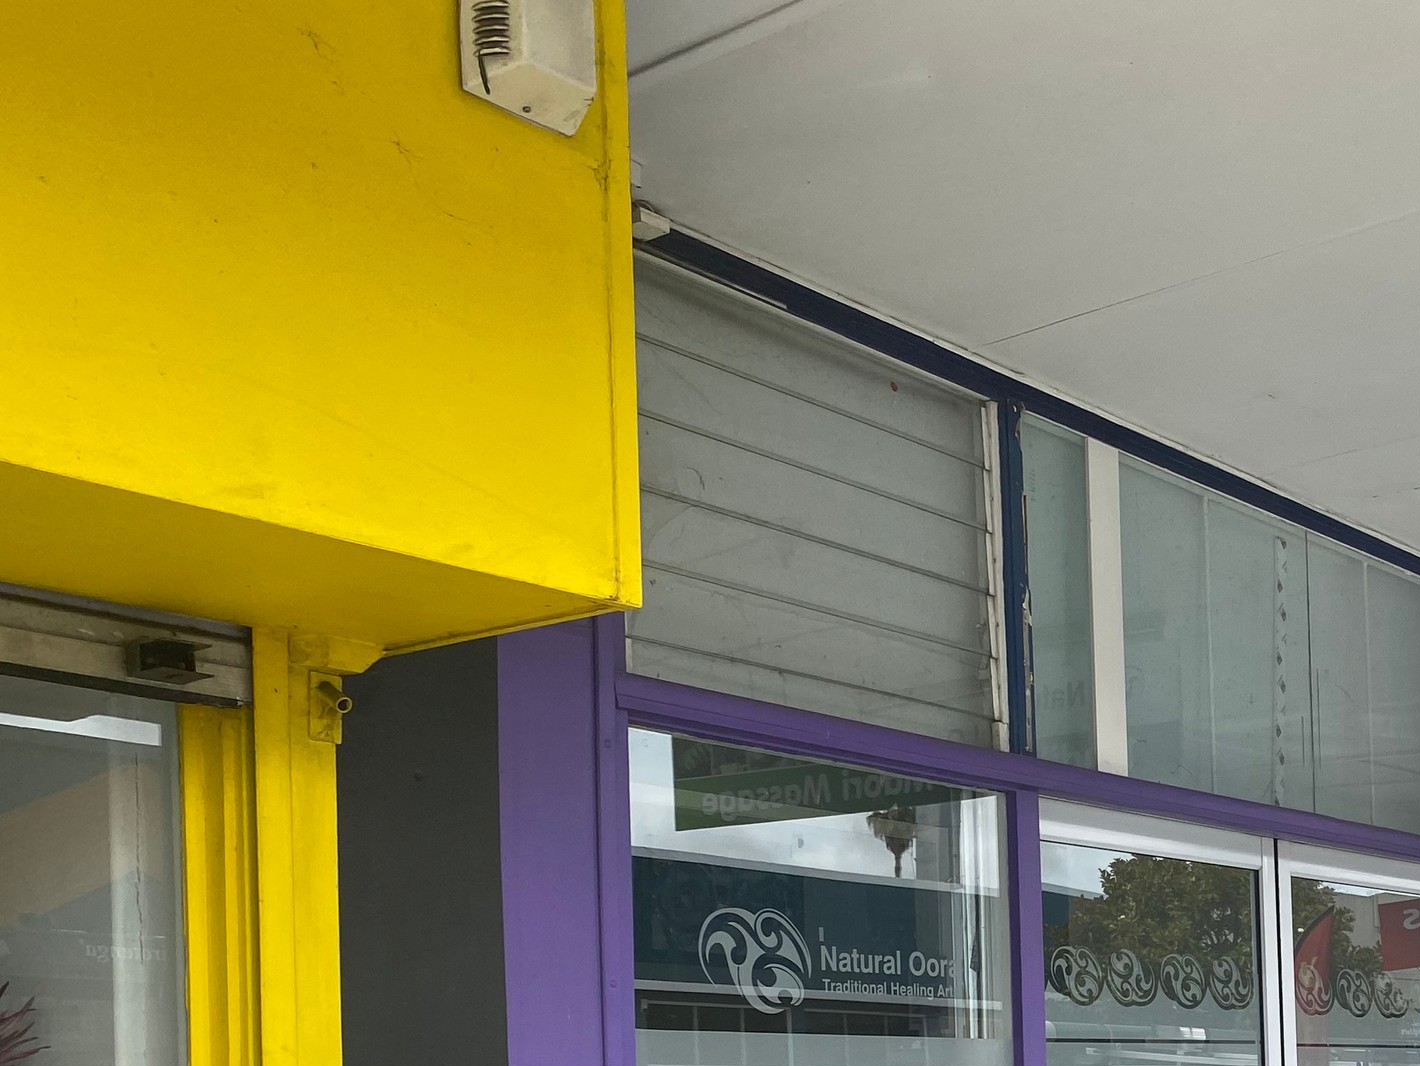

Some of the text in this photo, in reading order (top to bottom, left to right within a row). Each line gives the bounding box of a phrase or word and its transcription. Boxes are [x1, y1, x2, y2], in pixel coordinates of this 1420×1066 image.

[820, 945, 957, 978] Natural Oora
[822, 979, 955, 1000] Traditional Healing Art
